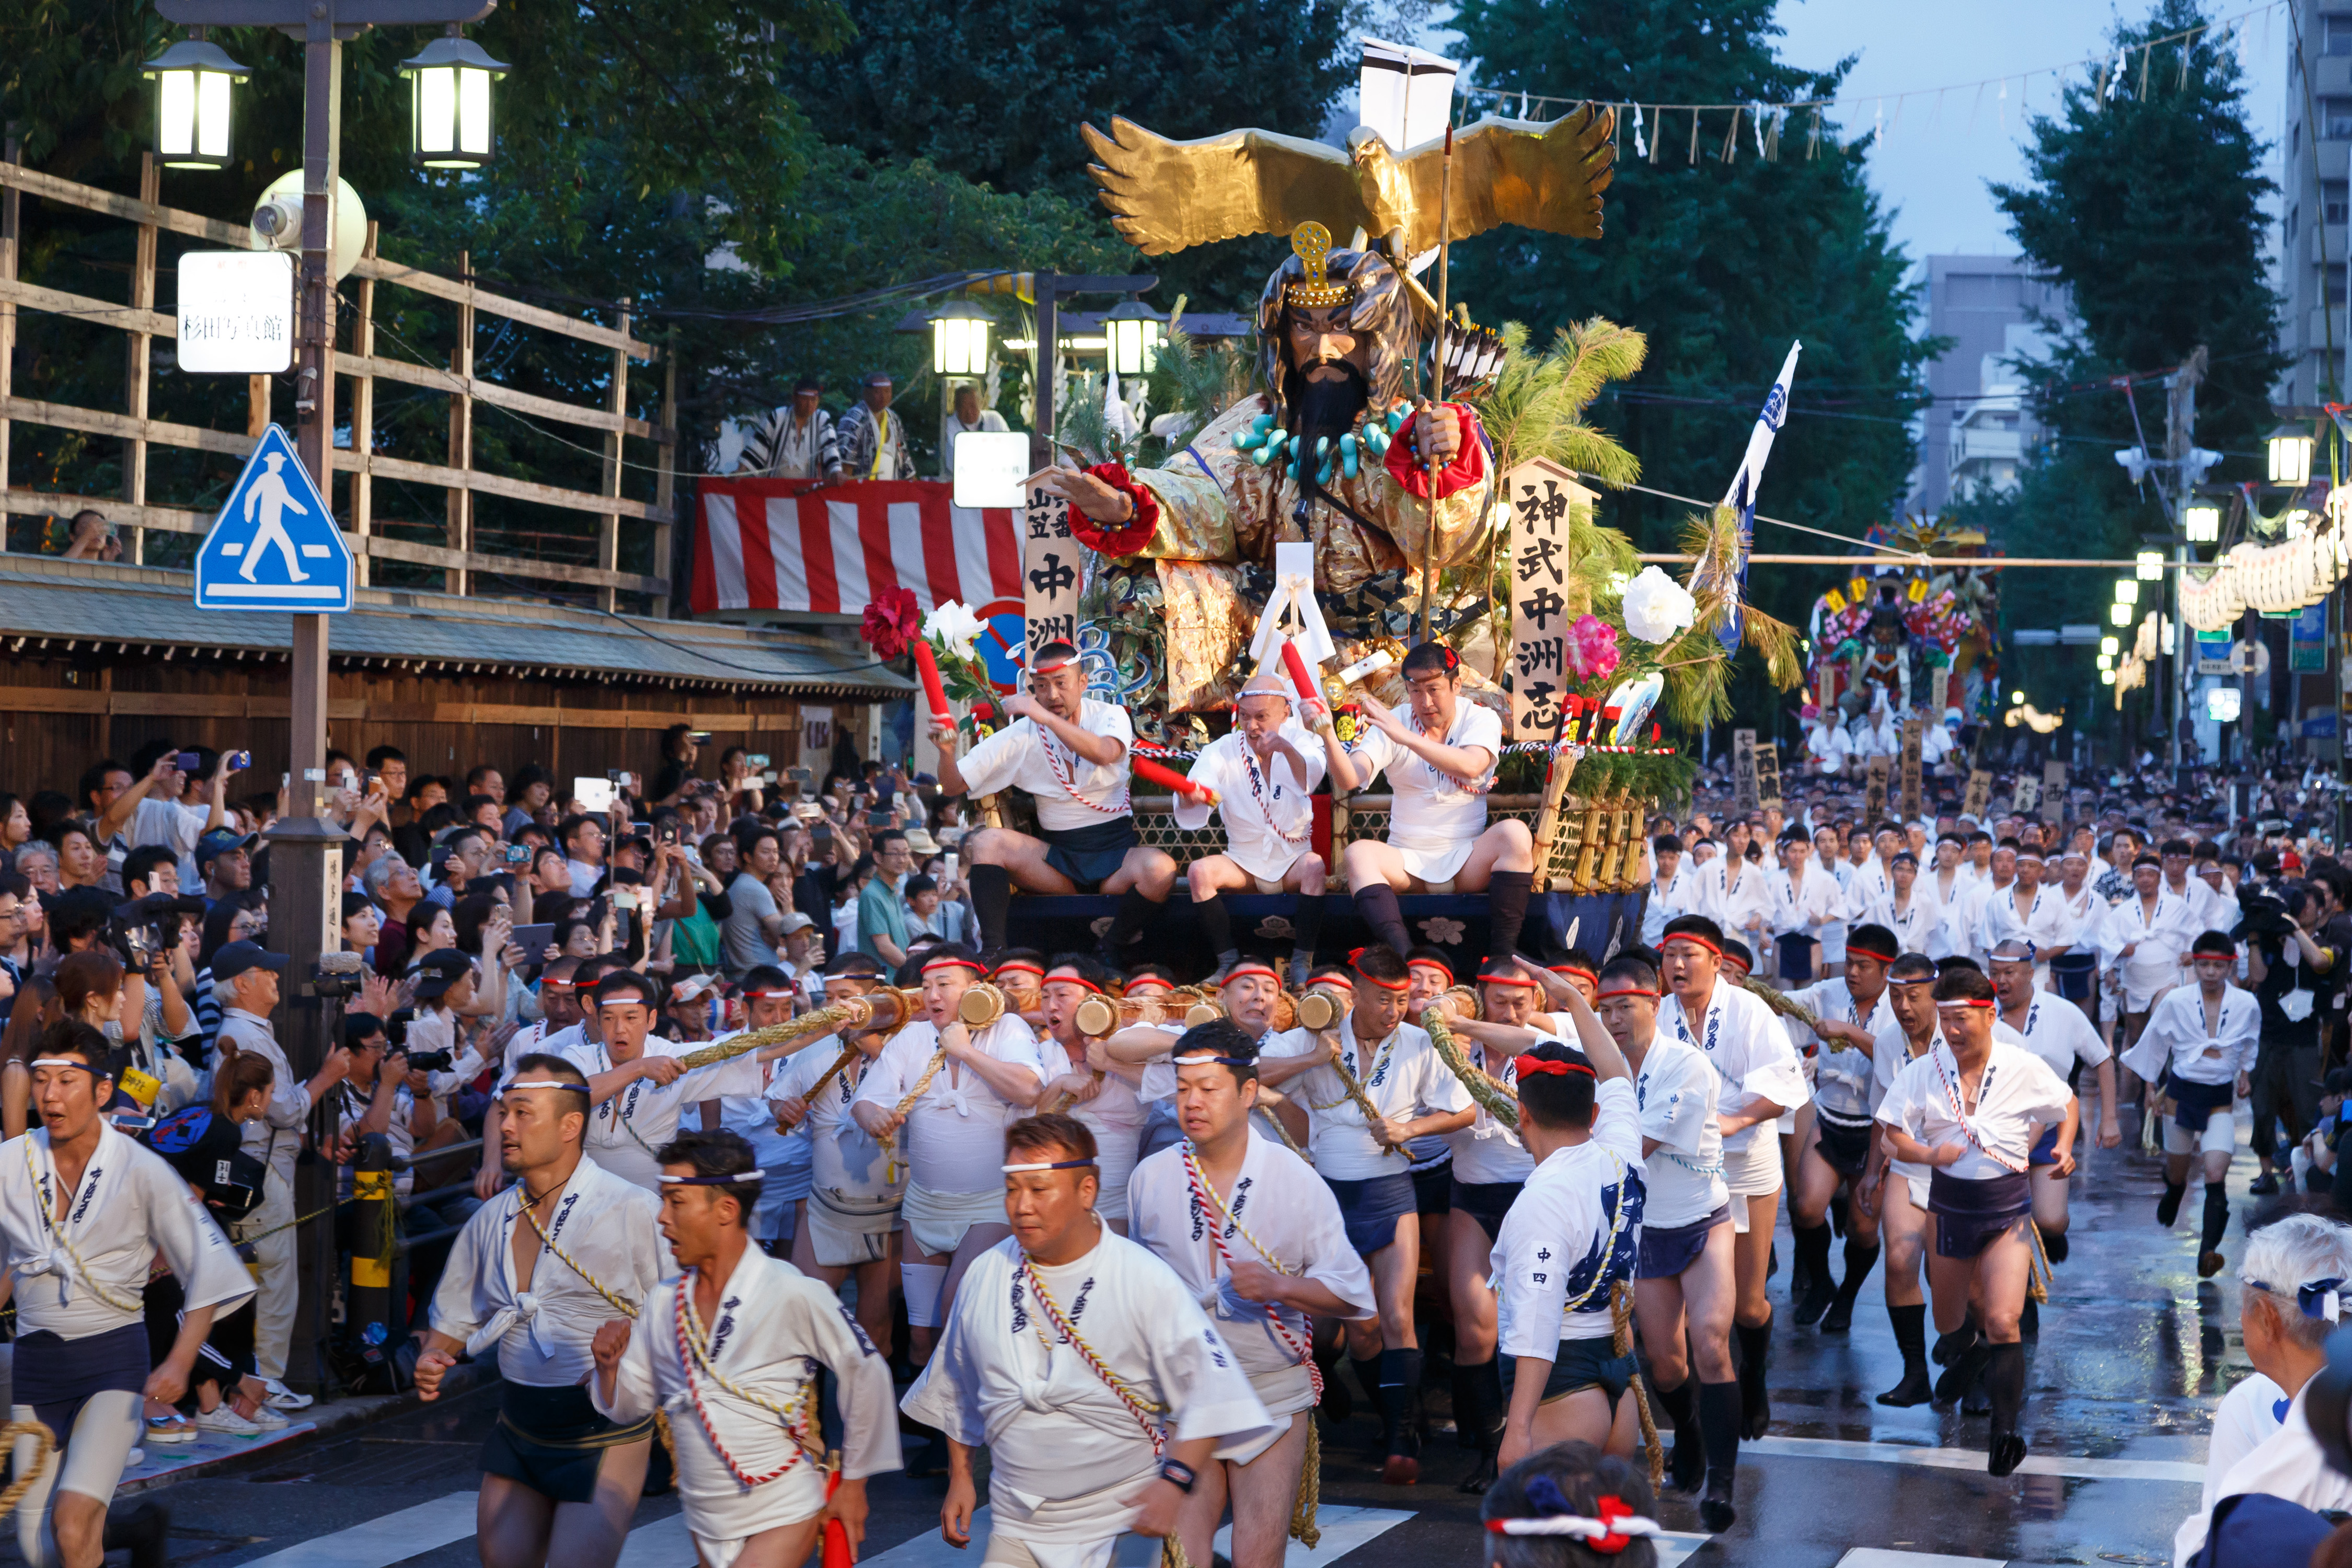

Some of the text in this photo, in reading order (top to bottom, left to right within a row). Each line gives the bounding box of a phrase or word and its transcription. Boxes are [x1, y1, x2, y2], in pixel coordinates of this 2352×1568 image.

[1026, 552, 1076, 694] 中洲
[1516, 480, 1568, 730] 神武中洲志
[1532, 1247, 1551, 1285] 中四
